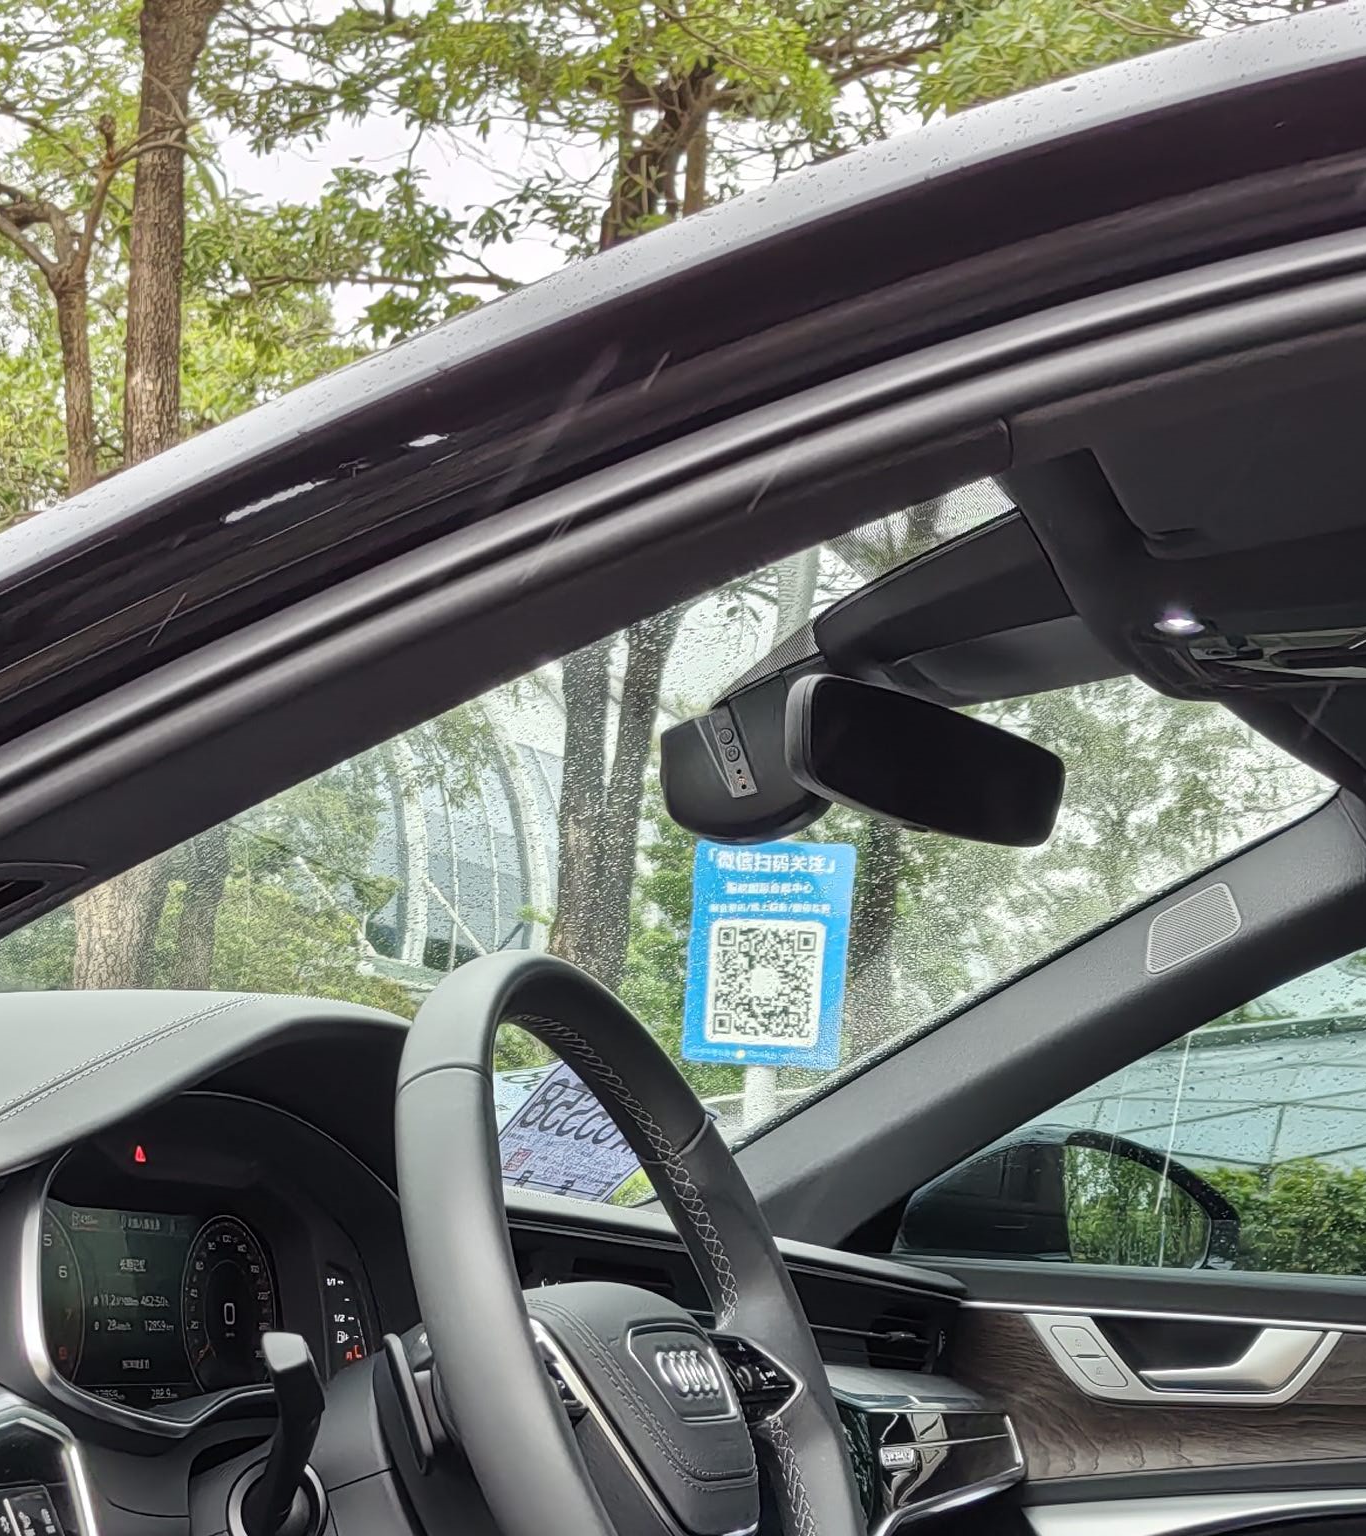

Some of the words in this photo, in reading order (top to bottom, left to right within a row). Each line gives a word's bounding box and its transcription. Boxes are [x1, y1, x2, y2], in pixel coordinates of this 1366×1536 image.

[43, 1234, 52, 1247] 5
[58, 1265, 68, 1279] 6
[224, 1302, 236, 1325] 0
[333, 1314, 346, 1323] 1/2
